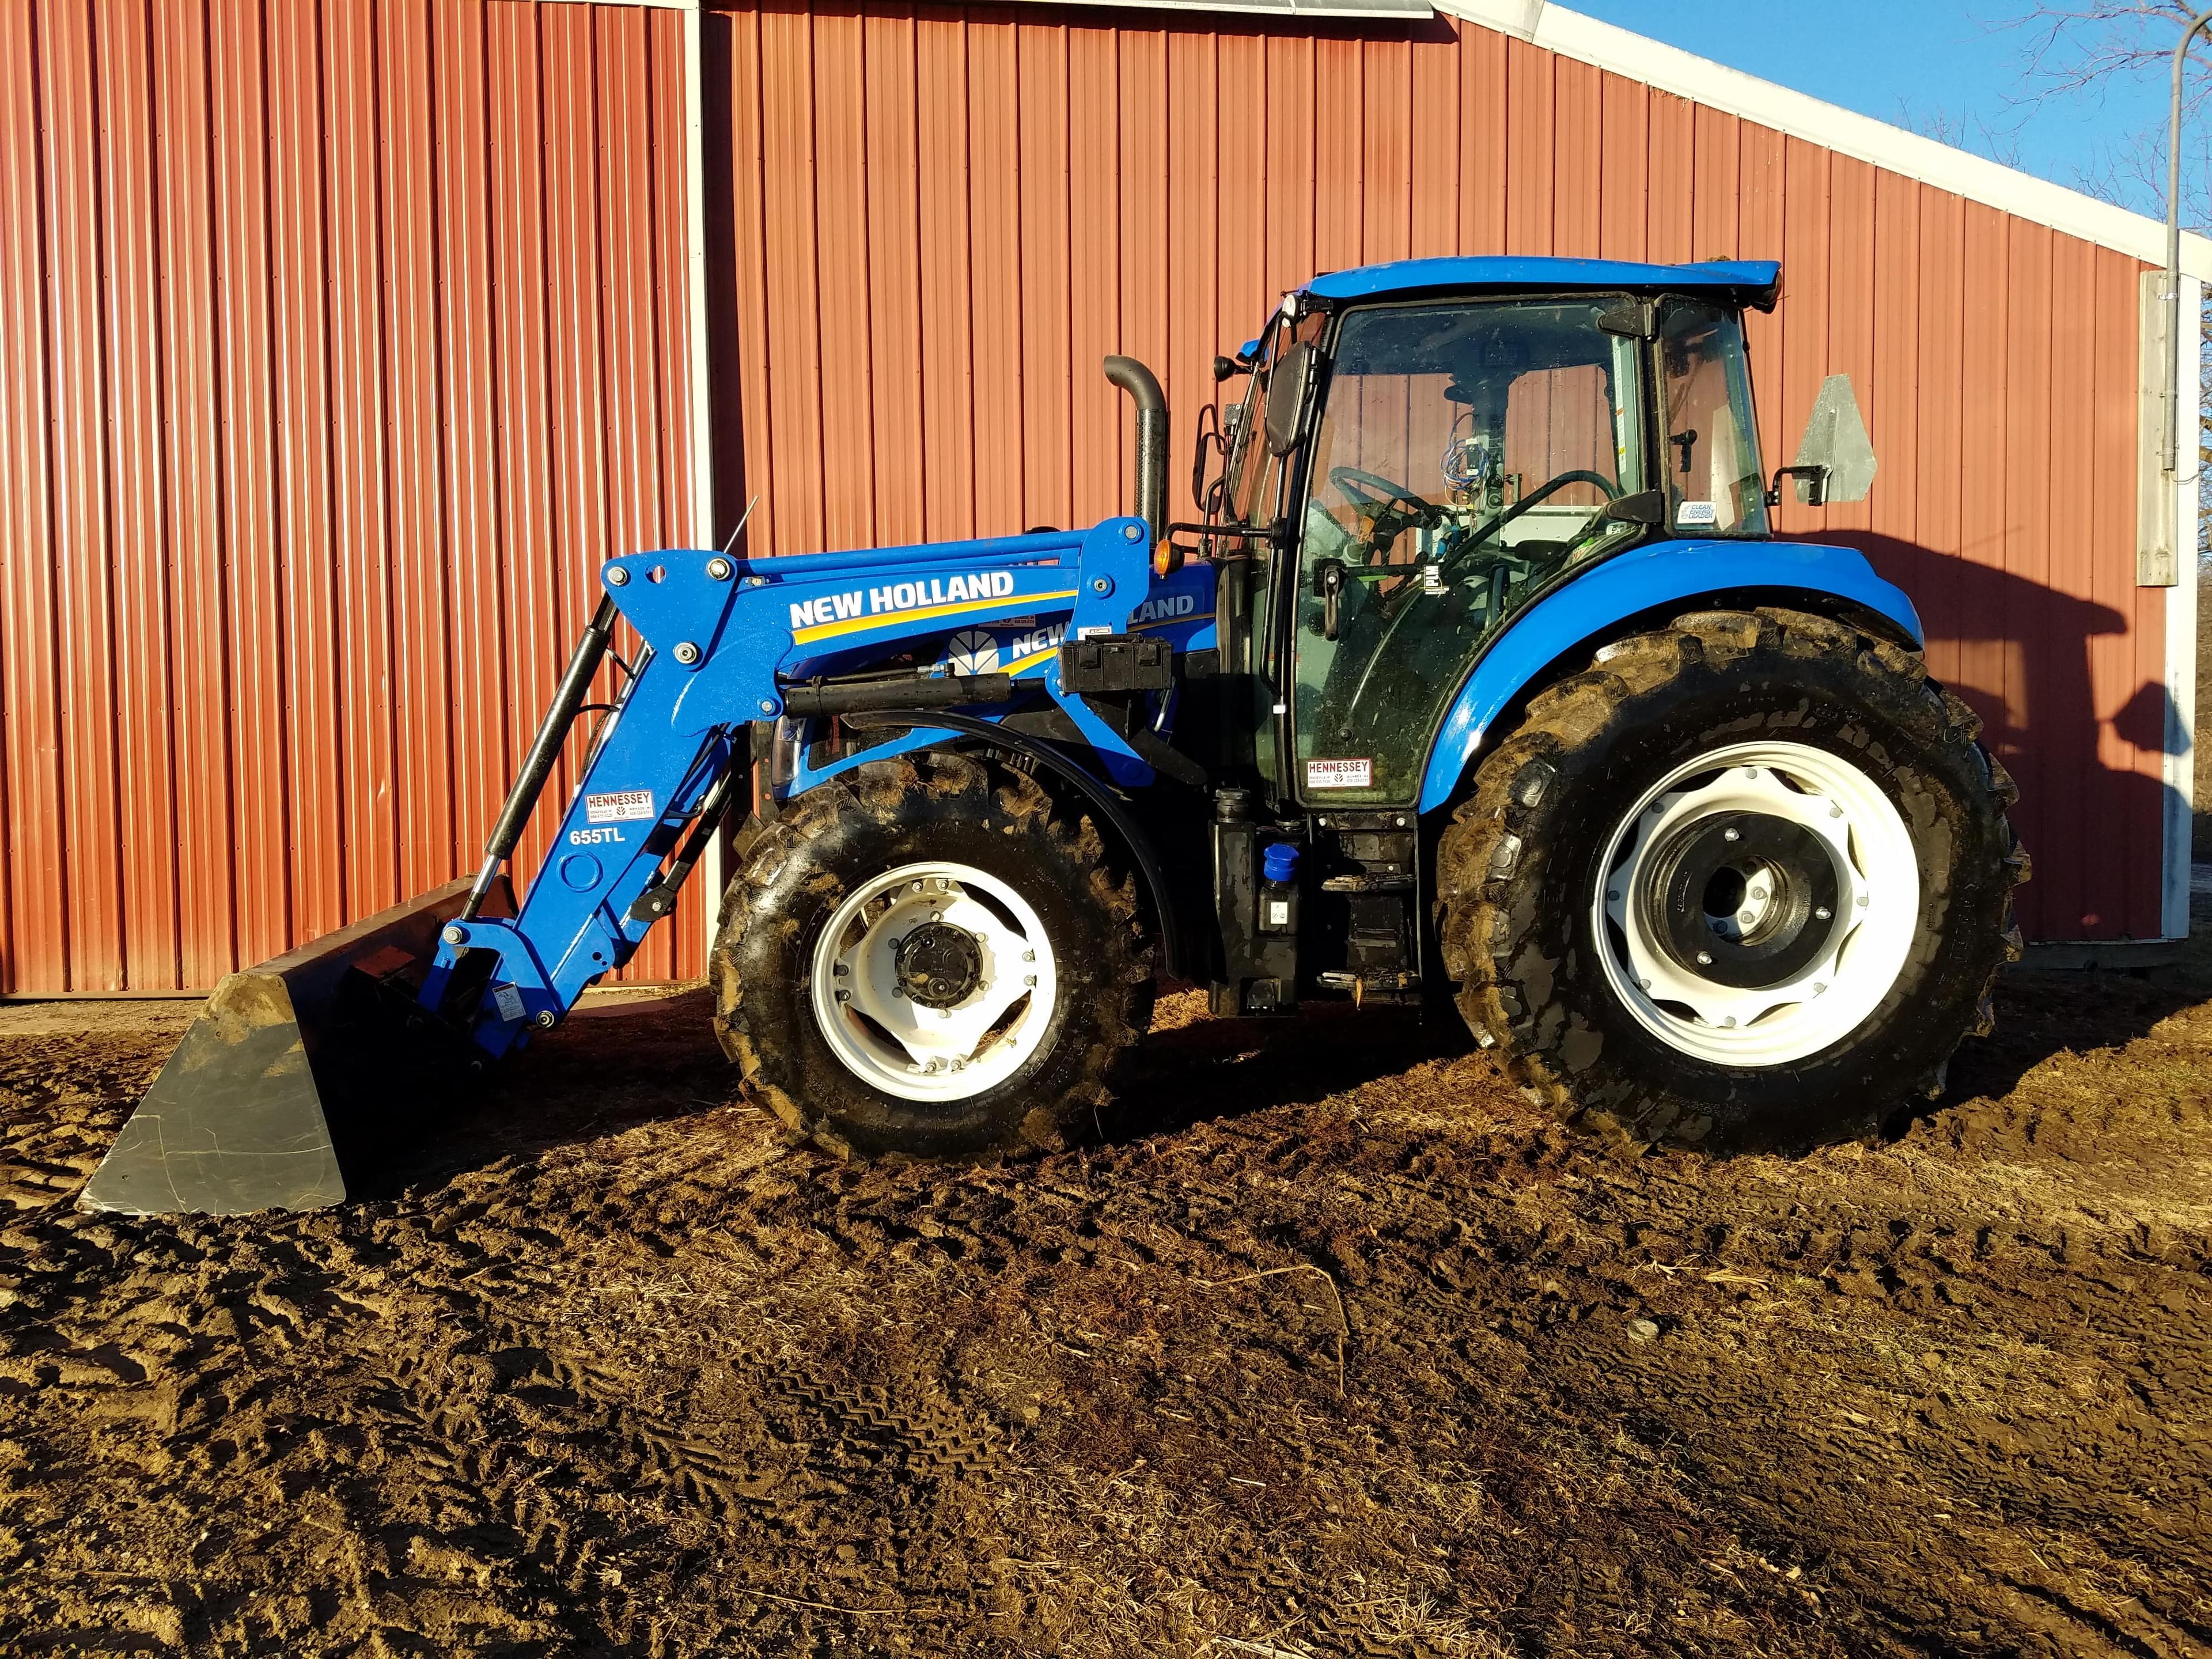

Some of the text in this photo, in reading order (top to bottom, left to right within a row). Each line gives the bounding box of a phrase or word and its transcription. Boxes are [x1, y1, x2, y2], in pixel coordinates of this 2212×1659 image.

[1426, 566, 1438, 586] PLM
[790, 572, 1014, 628] NEW HOLLAND
[1012, 595, 1194, 660] NEW LAND
[1309, 762, 1368, 773] HENNESSEY
[589, 793, 649, 808] HENNESSEY
[570, 827, 625, 846] 655TL
